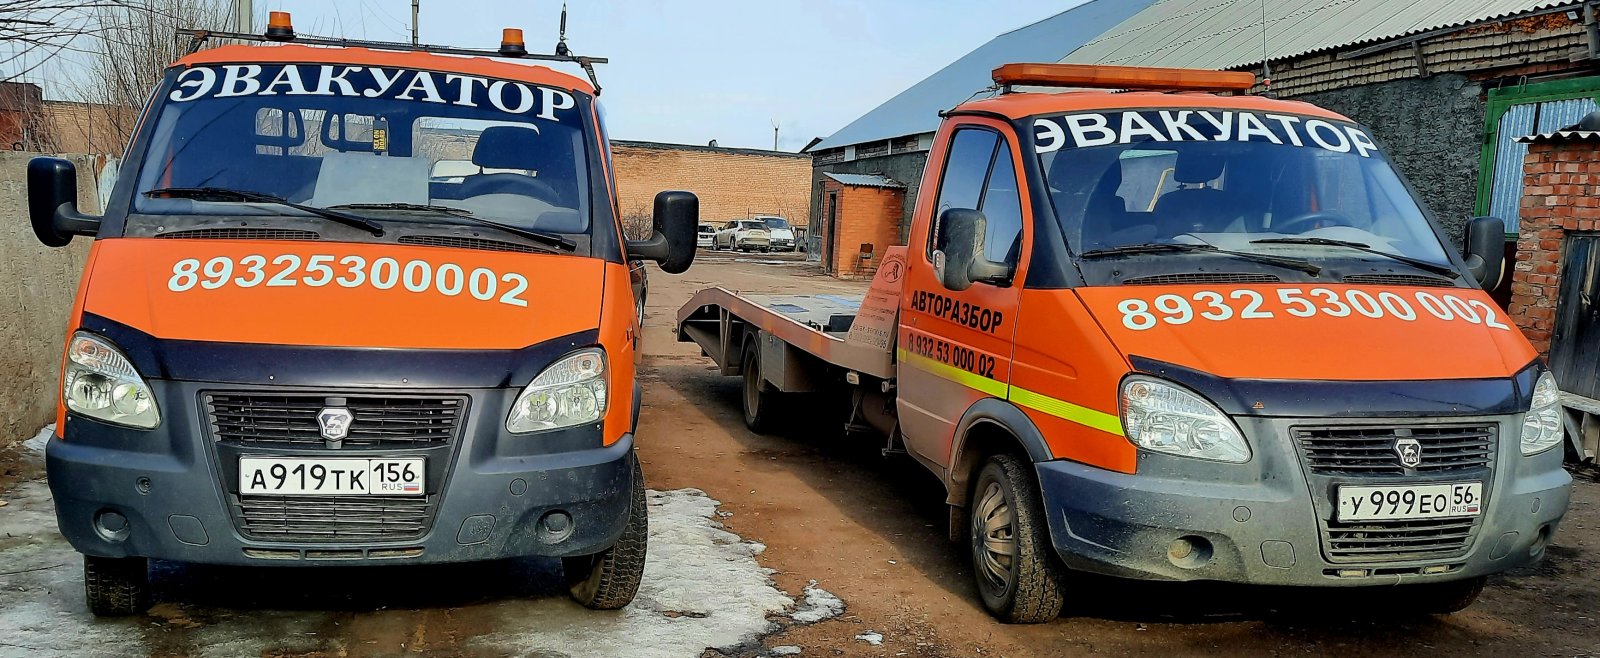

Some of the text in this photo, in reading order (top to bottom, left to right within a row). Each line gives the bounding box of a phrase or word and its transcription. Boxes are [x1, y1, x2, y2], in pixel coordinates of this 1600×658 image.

[170, 64, 575, 122] ЭВАКУАТОР
[1033, 110, 1379, 158] ЭВАКУАТОР
[167, 254, 529, 307] 89325300002
[911, 290, 1003, 334] АВТОРАЗБОР
[908, 333, 914, 352] 8
[916, 335, 934, 358] 932
[936, 341, 950, 363] 53
[952, 346, 975, 372] 000
[978, 354, 995, 379] 02
[373, 463, 415, 482] 156
[381, 483, 403, 491] RUS
[1453, 486, 1474, 504] 56
